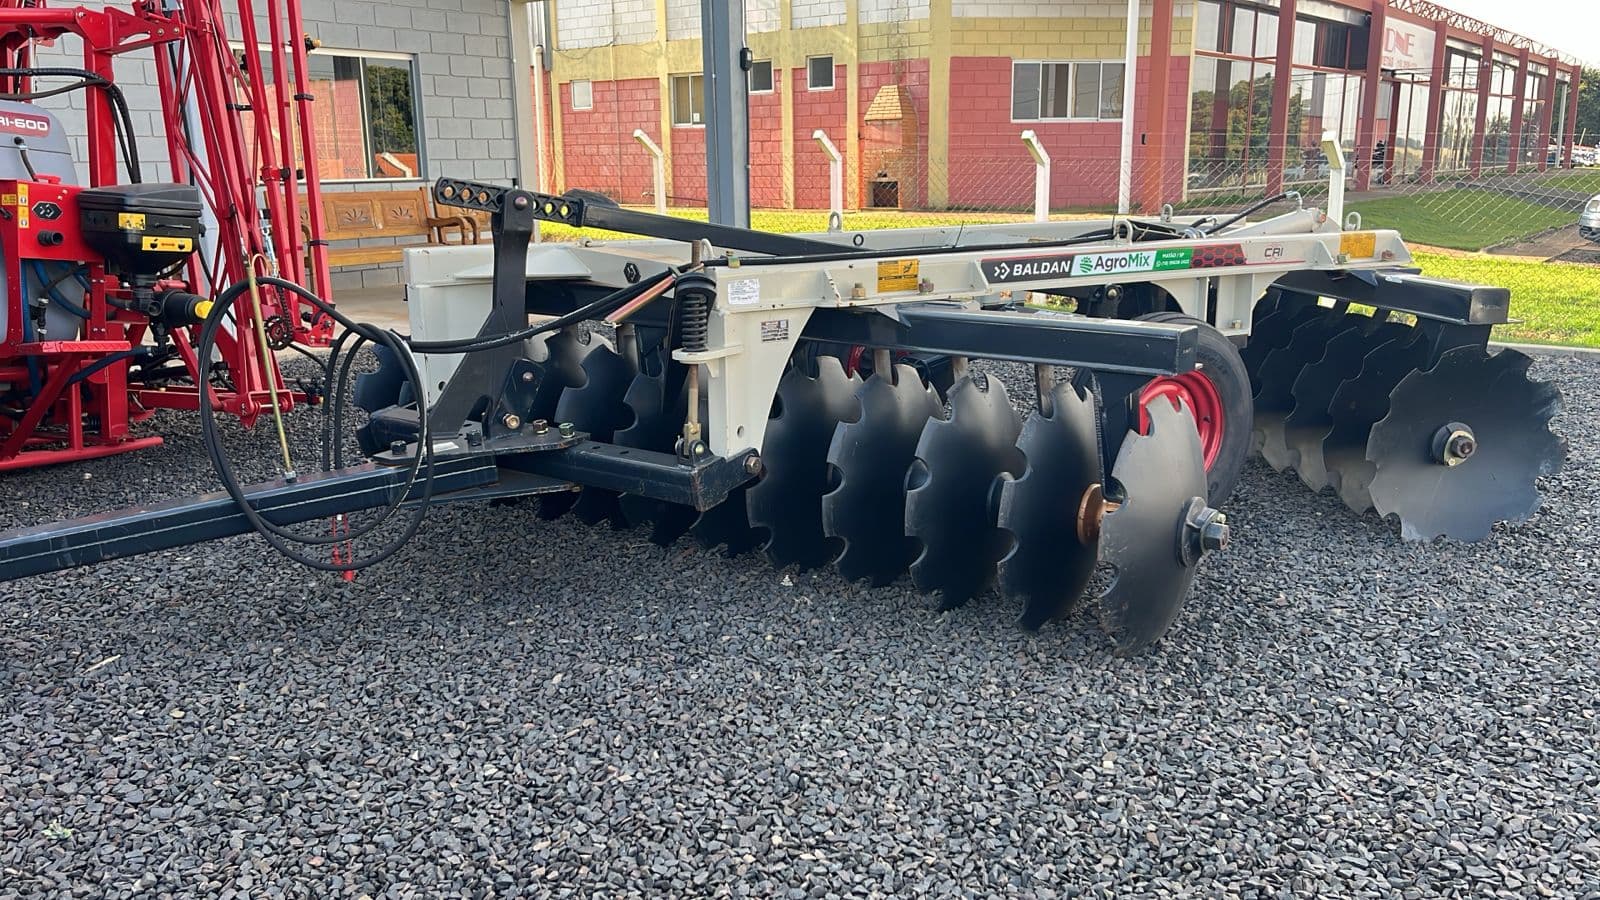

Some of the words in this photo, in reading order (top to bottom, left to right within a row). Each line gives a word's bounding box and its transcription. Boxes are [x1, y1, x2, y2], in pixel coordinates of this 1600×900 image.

[1264, 247, 1284, 257] CRI
[1012, 260, 1071, 276] BALDAN
[1094, 253, 1150, 271] AgroMix
